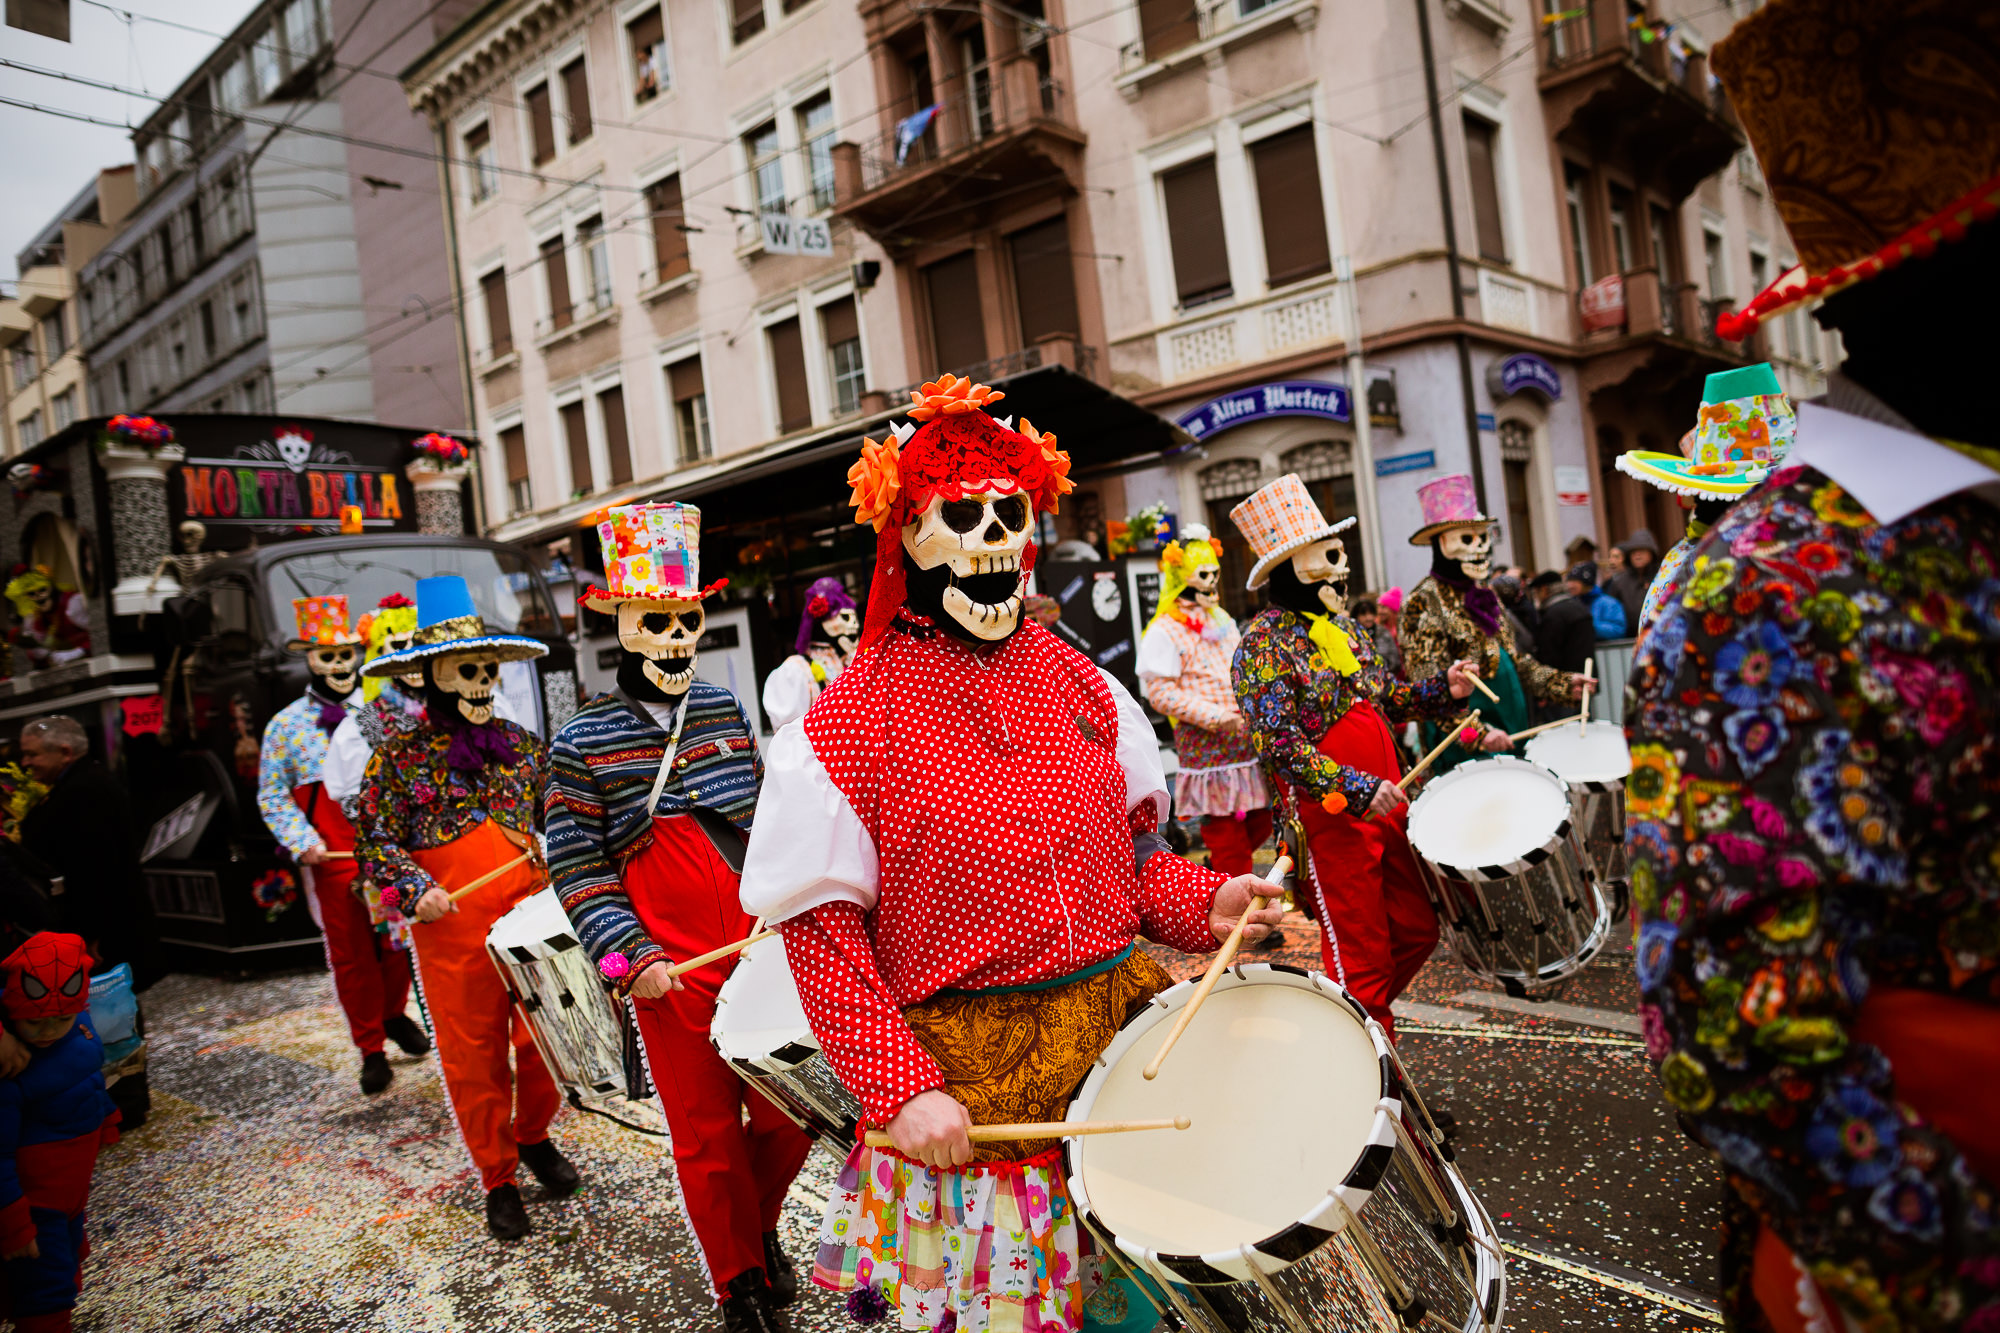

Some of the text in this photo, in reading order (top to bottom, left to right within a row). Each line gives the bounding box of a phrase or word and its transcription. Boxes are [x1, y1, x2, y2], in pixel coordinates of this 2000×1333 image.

[766, 221, 827, 249] W 25
[1208, 396, 1256, 429] Alten
[1263, 385, 1340, 414] Warteck
[181, 466, 403, 520] MORTA BELLA
[130, 710, 160, 727] 207
